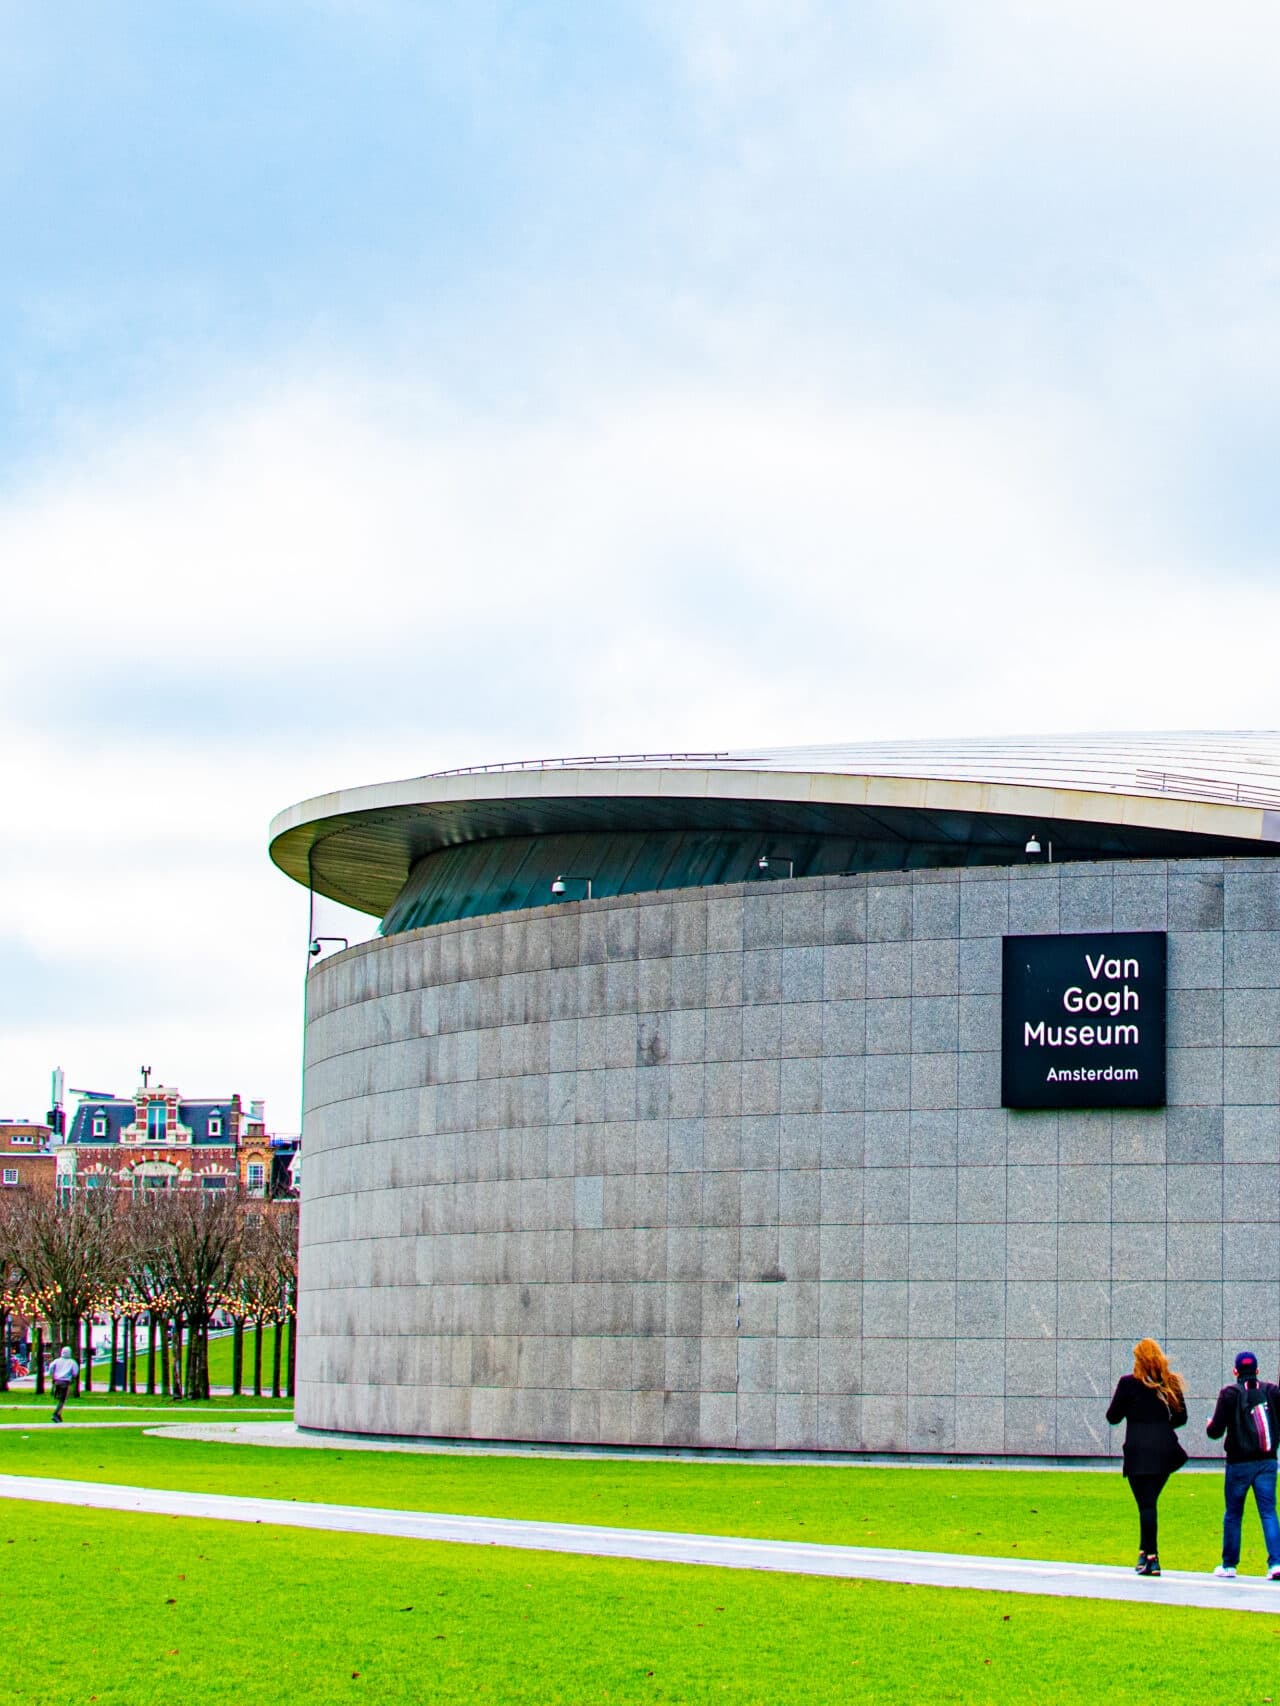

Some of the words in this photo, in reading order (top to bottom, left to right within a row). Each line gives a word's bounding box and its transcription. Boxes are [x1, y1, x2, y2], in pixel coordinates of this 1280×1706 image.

[1086, 954, 1138, 979] Van
[1064, 985, 1138, 1015] Gogh
[1025, 1022, 1138, 1046] Museum
[1047, 1066, 1138, 1081] Amsterdam
